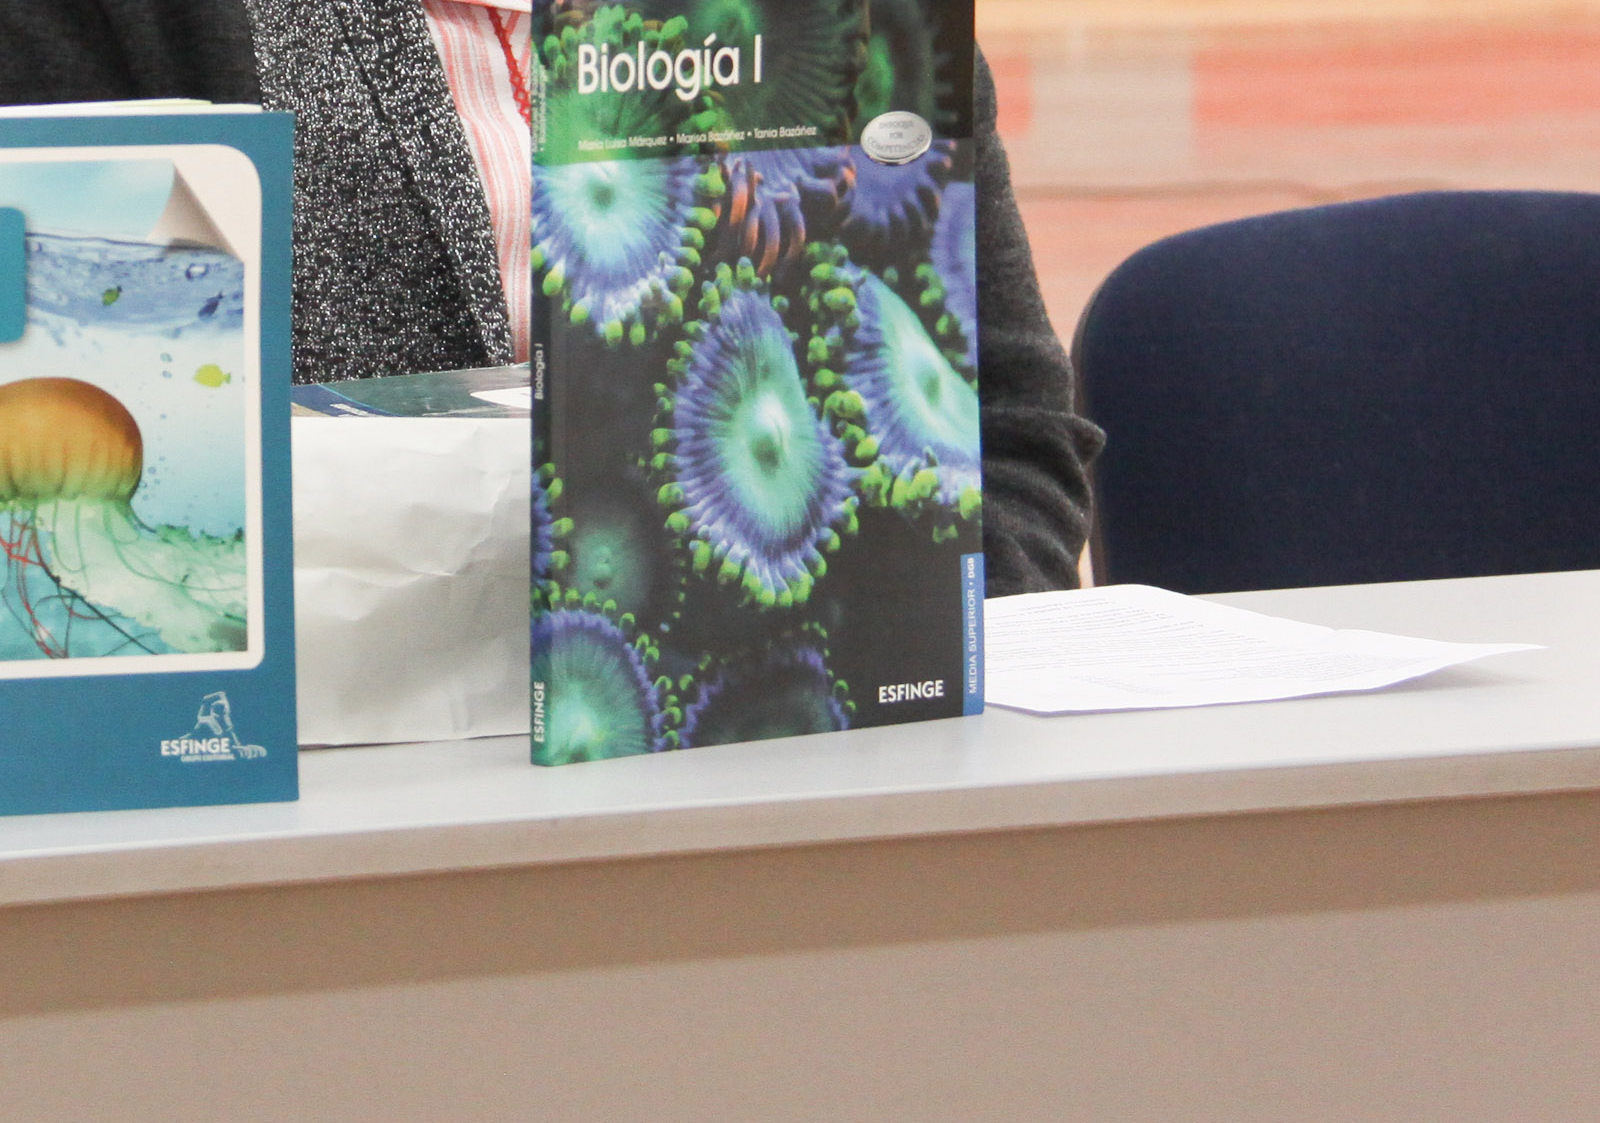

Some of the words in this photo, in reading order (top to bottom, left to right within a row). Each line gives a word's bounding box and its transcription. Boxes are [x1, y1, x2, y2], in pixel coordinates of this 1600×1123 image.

[577, 32, 741, 102] Biología
[753, 33, 763, 84] I
[966, 588, 978, 653] SUPERIOR
[878, 679, 945, 704] ESFINGE
[968, 653, 978, 695] MEDIA
[533, 681, 546, 743] ESFINGE
[160, 737, 231, 757] ESFINGE
